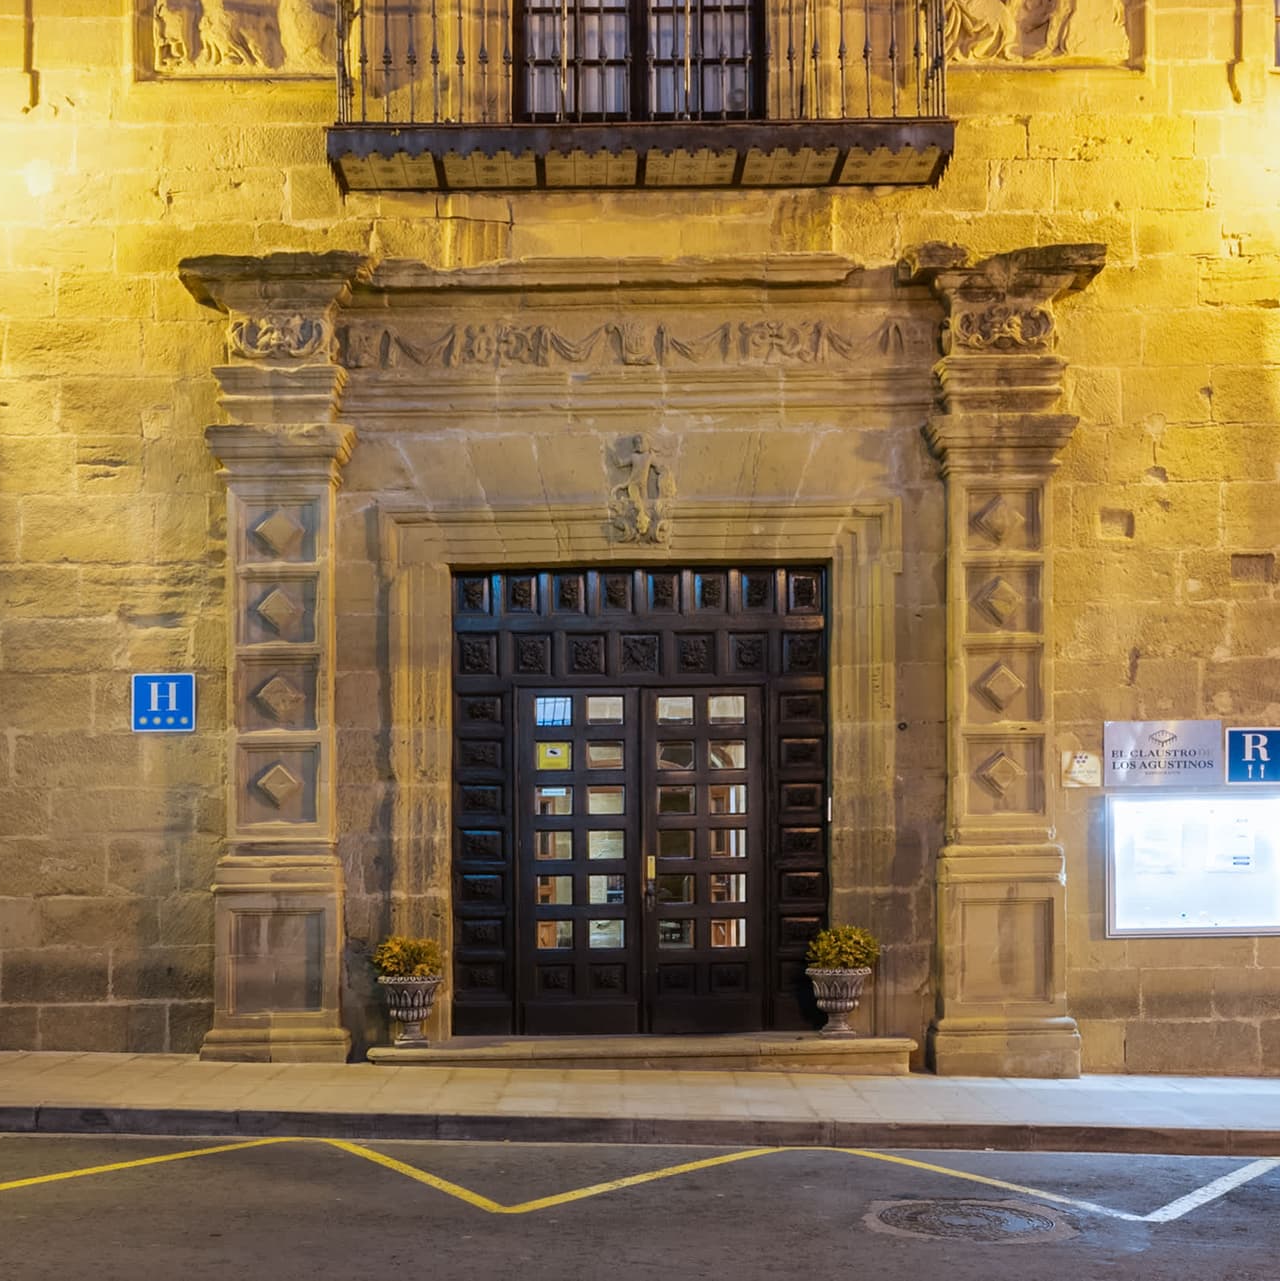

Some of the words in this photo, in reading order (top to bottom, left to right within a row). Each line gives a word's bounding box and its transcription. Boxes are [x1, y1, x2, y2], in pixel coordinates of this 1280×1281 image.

[146, 681, 181, 712] H
[1111, 749, 1126, 758] EL
[1130, 749, 1197, 758] CLAUSTRO
[1241, 733, 1271, 762] R
[1112, 760, 1137, 770] LOS
[1139, 760, 1214, 769] AGUSTINOS
